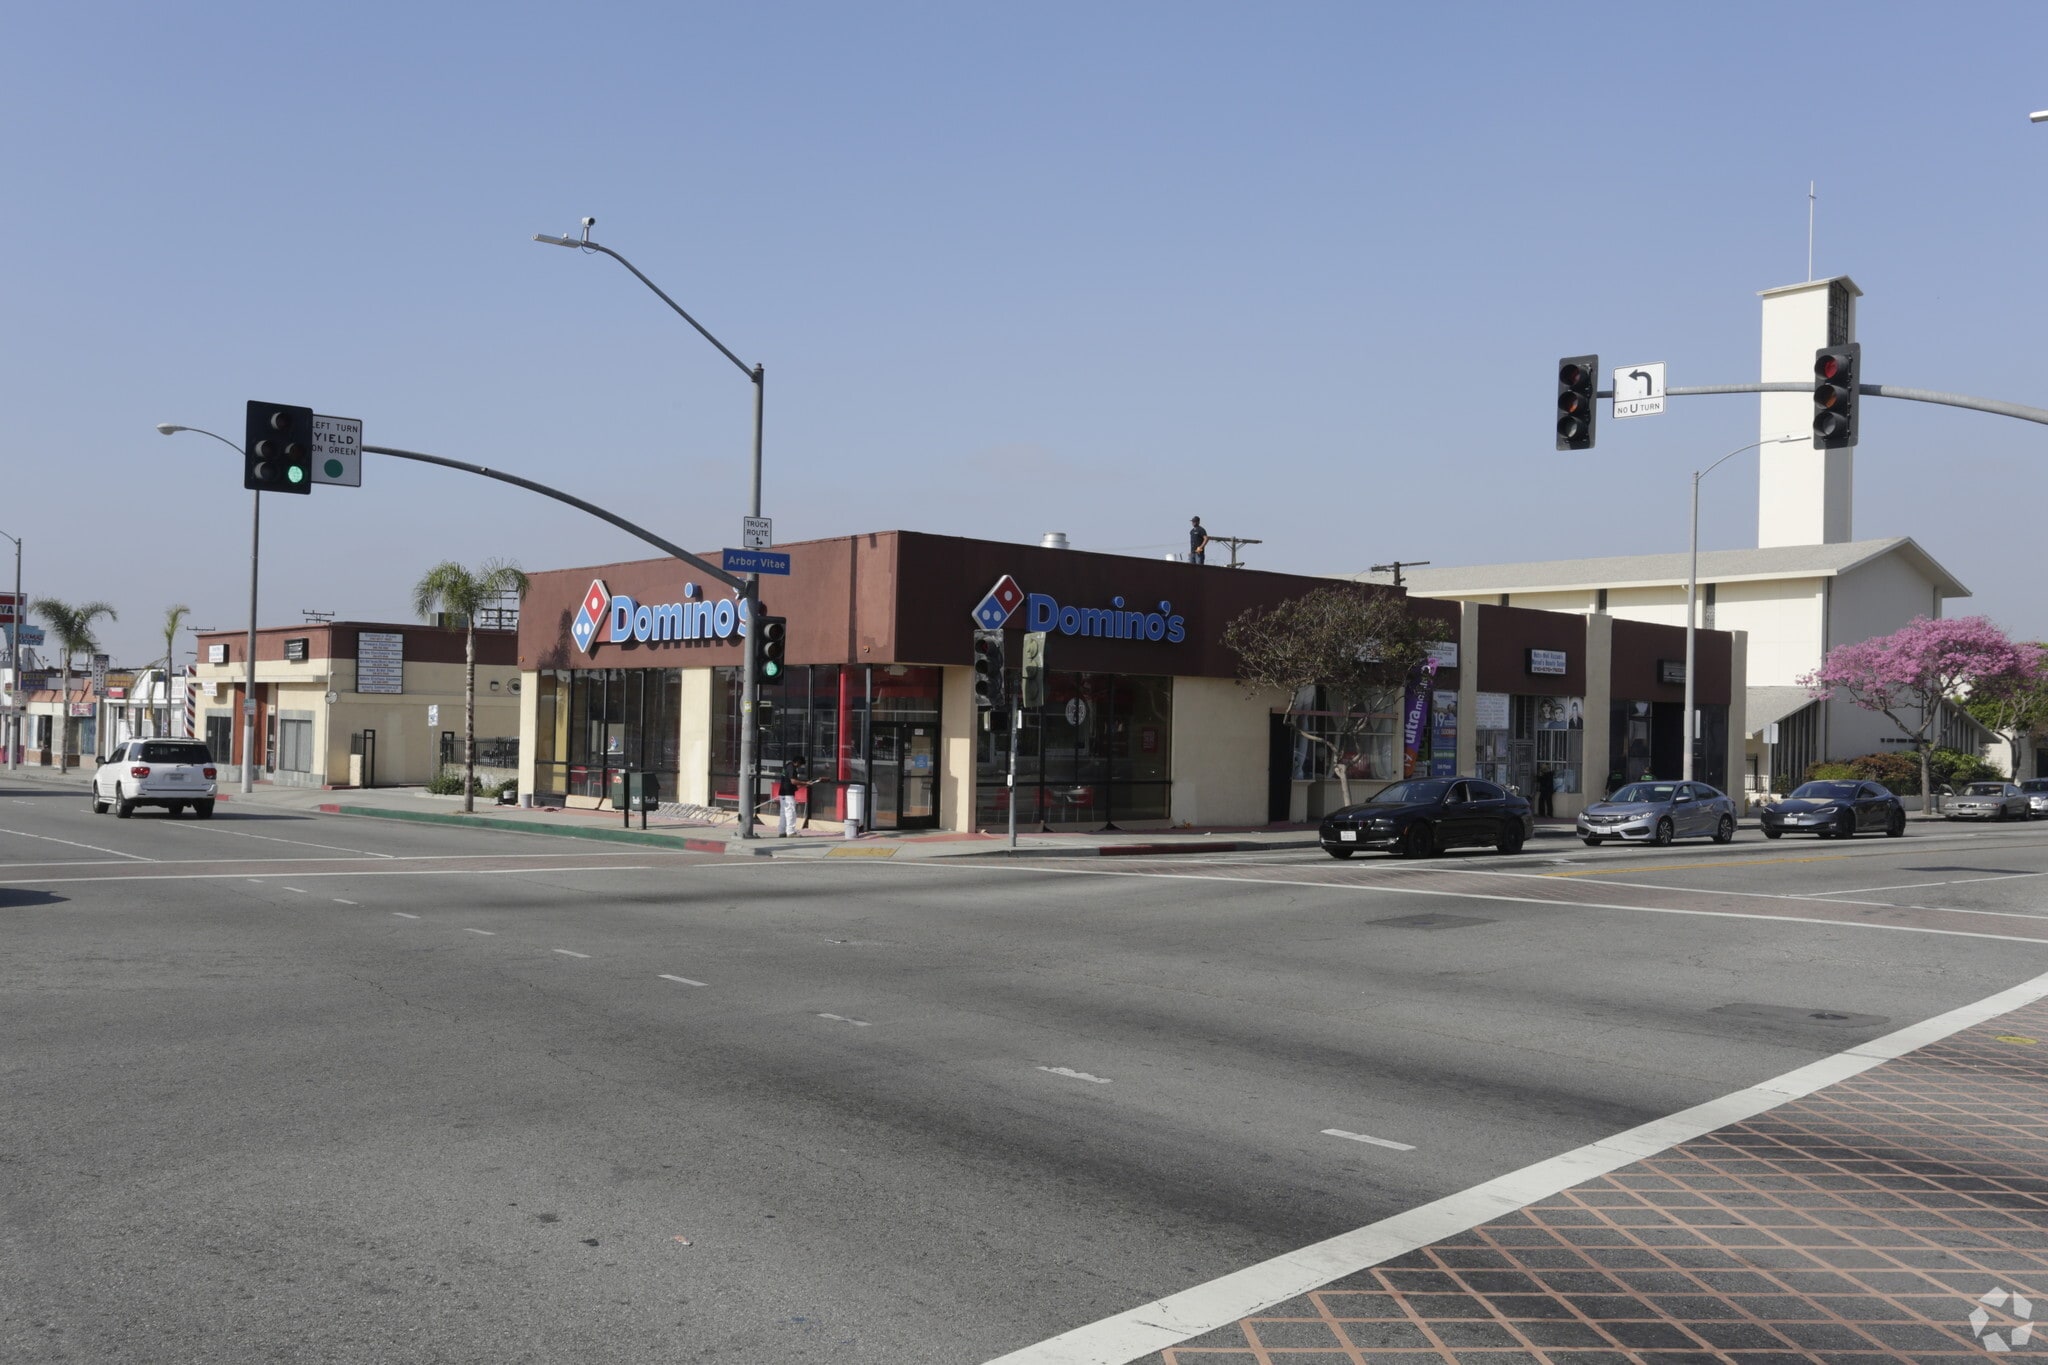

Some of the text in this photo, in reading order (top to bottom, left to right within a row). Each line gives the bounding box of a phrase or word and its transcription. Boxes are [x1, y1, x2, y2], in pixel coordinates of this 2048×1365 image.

[1617, 403, 1660, 414] NO U TURN
[312, 421, 358, 433] EFT TURN
[313, 431, 354, 445] YIELD
[312, 444, 356, 456] ON GREEN
[746, 520, 769, 528] TRUCK
[746, 528, 769, 537] ROUTE
[728, 556, 786, 569] Arbor Vitae
[1026, 593, 1185, 643] Domino's
[1405, 709, 1420, 744] ultra
